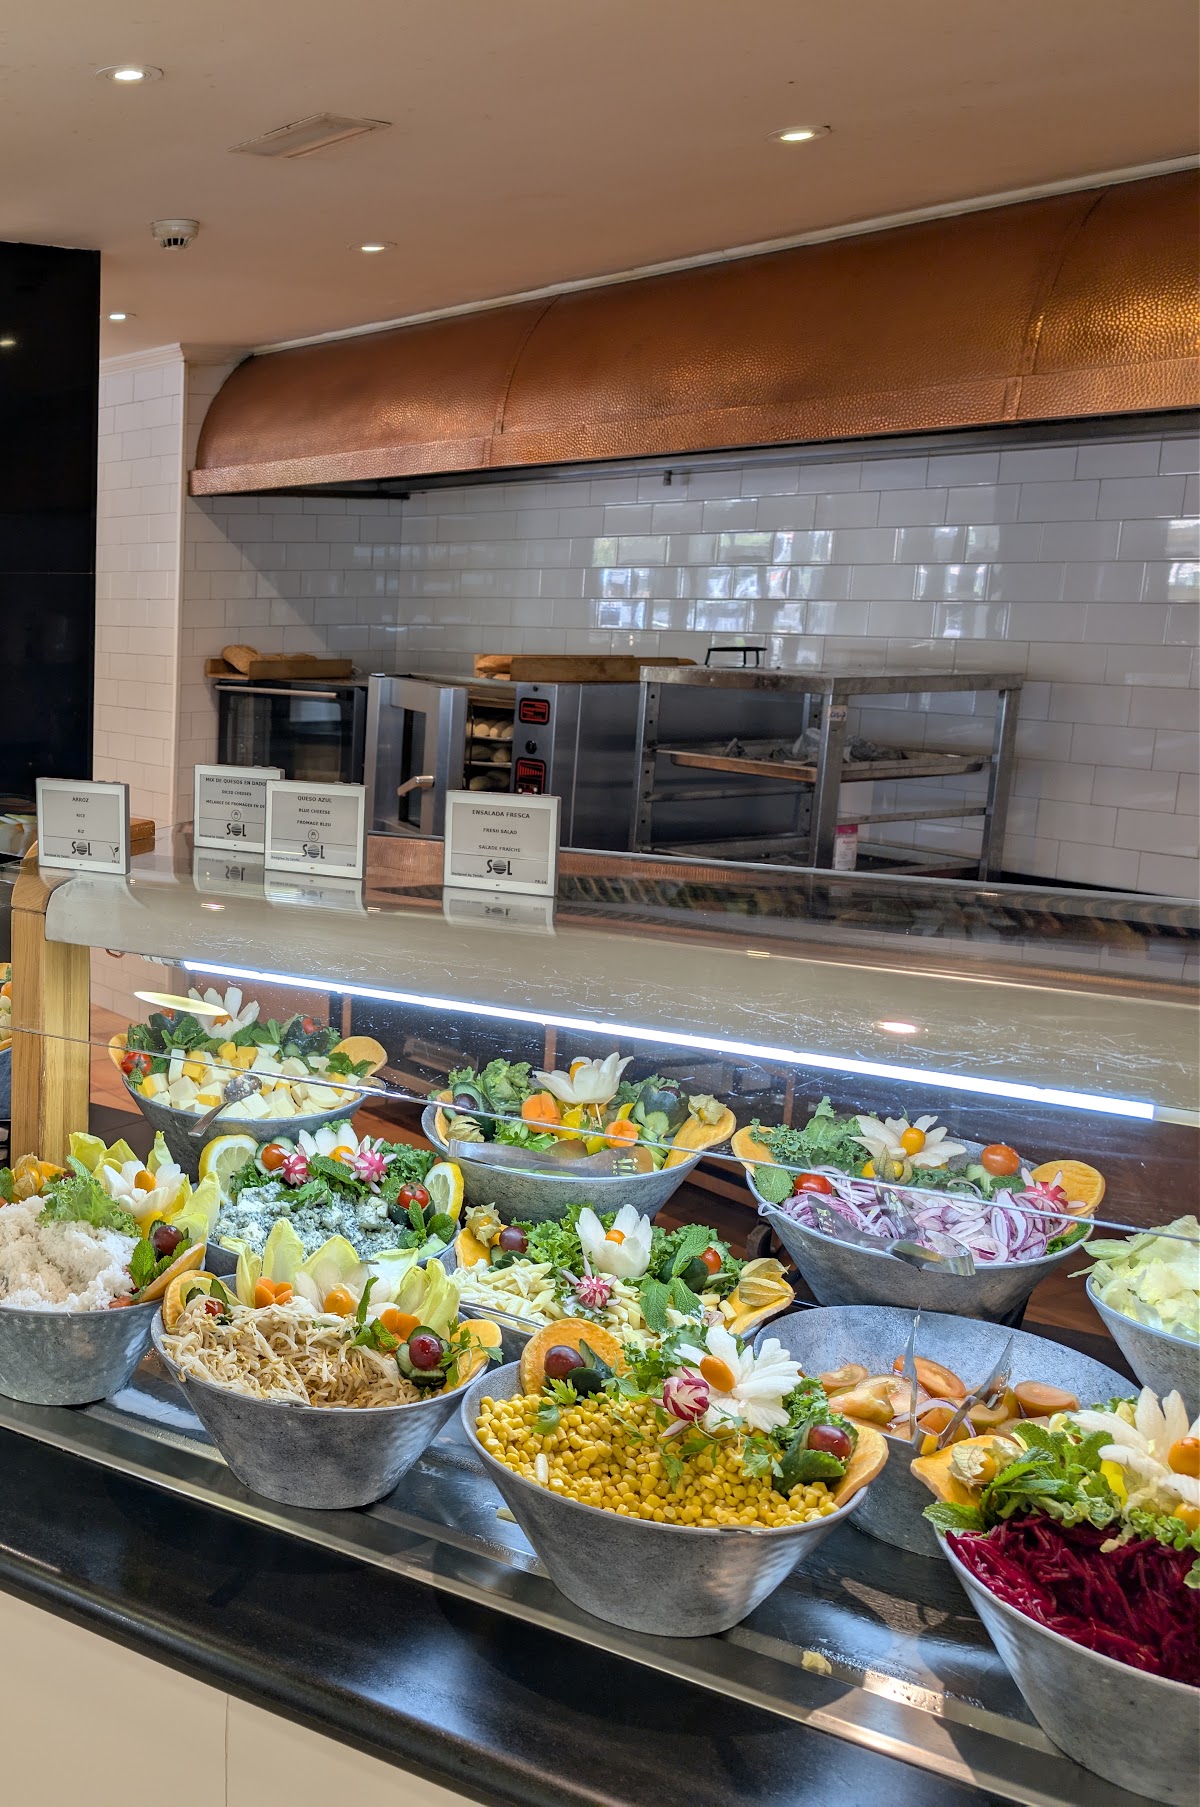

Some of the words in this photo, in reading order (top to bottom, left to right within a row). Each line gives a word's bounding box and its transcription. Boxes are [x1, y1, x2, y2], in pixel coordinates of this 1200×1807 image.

[472, 809, 505, 817] ENSALADA
[226, 823, 247, 837] SOL
[71, 841, 92, 856] SOL
[302, 844, 325, 859] SOL
[486, 859, 513, 876] SOL
